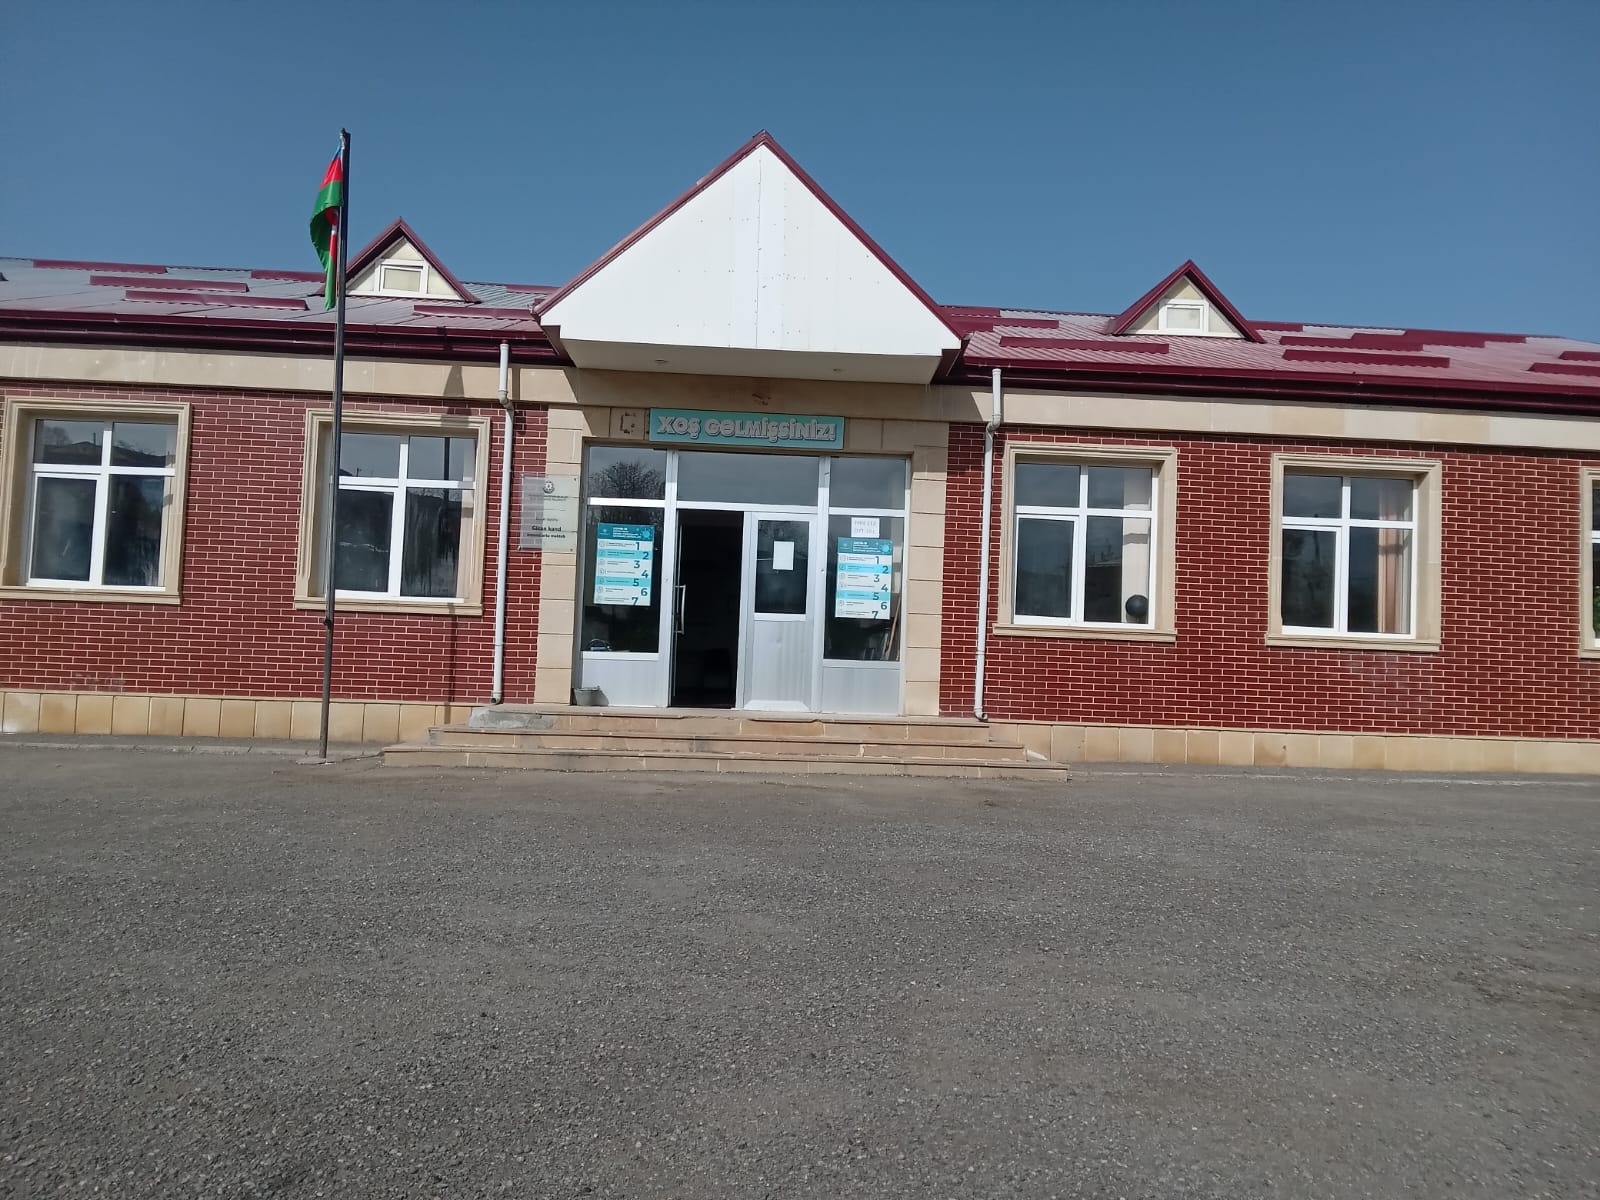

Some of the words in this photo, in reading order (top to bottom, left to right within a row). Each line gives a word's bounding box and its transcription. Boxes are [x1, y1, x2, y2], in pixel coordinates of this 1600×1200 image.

[657, 416, 700, 439] XOŞ
[635, 542, 640, 550] 1
[643, 551, 649, 560] 2
[633, 560, 640, 569] 3
[882, 565, 889, 574] 2
[641, 570, 649, 579] 4
[873, 574, 880, 583] 3
[633, 578, 639, 587] 5
[640, 588, 648, 596] 6
[881, 584, 888, 592] 4
[632, 597, 638, 605] 7
[872, 592, 879, 601] 5
[880, 601, 887, 610] 6
[872, 610, 878, 619] 7
